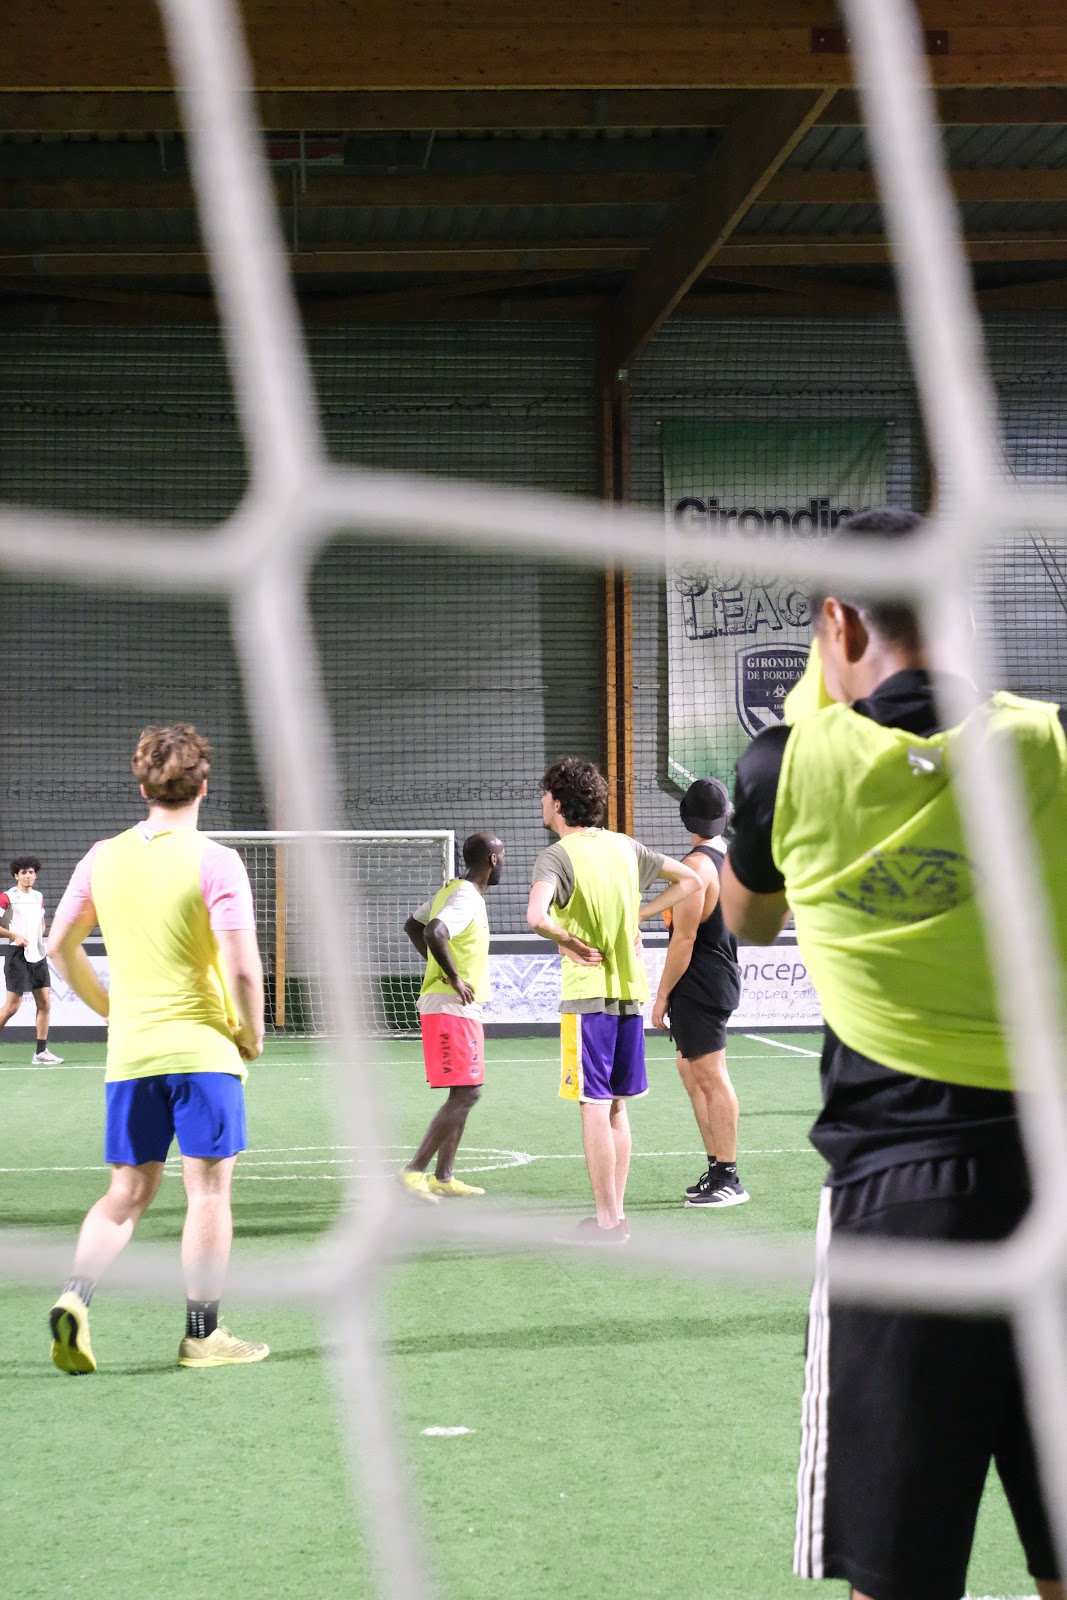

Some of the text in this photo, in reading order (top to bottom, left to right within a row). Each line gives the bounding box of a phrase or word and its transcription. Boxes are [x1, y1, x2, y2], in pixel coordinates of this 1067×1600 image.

[673, 496, 877, 540] Girondin
[747, 671, 760, 680] DE
[738, 963, 807, 986] ncep
[772, 990, 788, 1000] en
